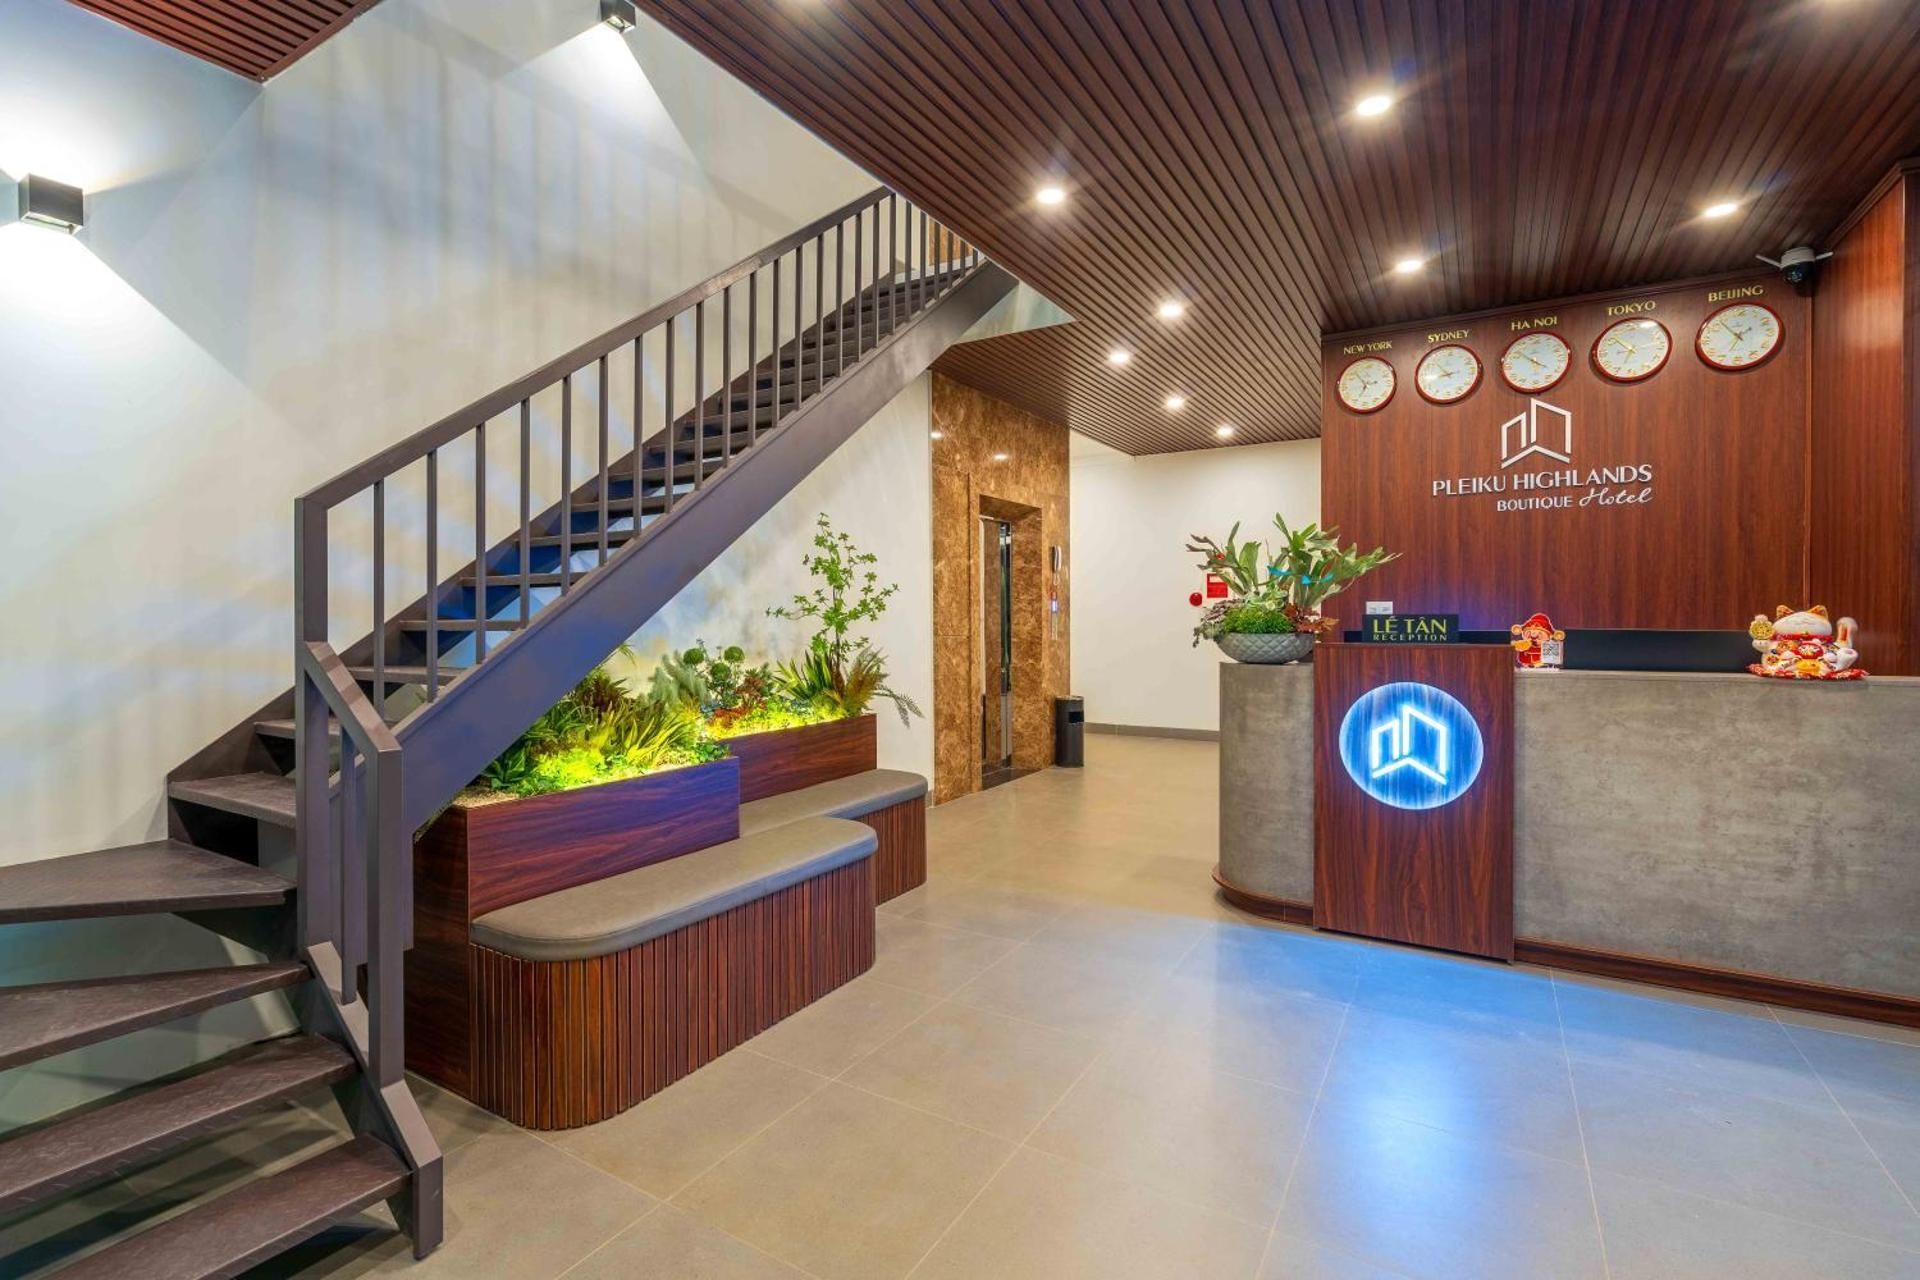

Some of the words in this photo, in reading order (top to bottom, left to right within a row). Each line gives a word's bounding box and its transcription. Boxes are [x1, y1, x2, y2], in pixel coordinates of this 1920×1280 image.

[1707, 285, 1764, 302] BEIJING
[1607, 300, 1656, 316] TOKYO
[1510, 319, 1531, 331] HA
[1534, 315, 1559, 328] NOI
[1427, 329, 1470, 343] SYDNEY
[1343, 345, 1366, 354] NEW
[1367, 341, 1393, 352] YORK
[1432, 475, 1506, 496] PLEIKU
[1513, 464, 1653, 490] HIGHLANDS
[1497, 496, 1573, 511] BOUTIQUE
[1578, 487, 1653, 507] Hotel
[1404, 616, 1448, 634] TÂN
